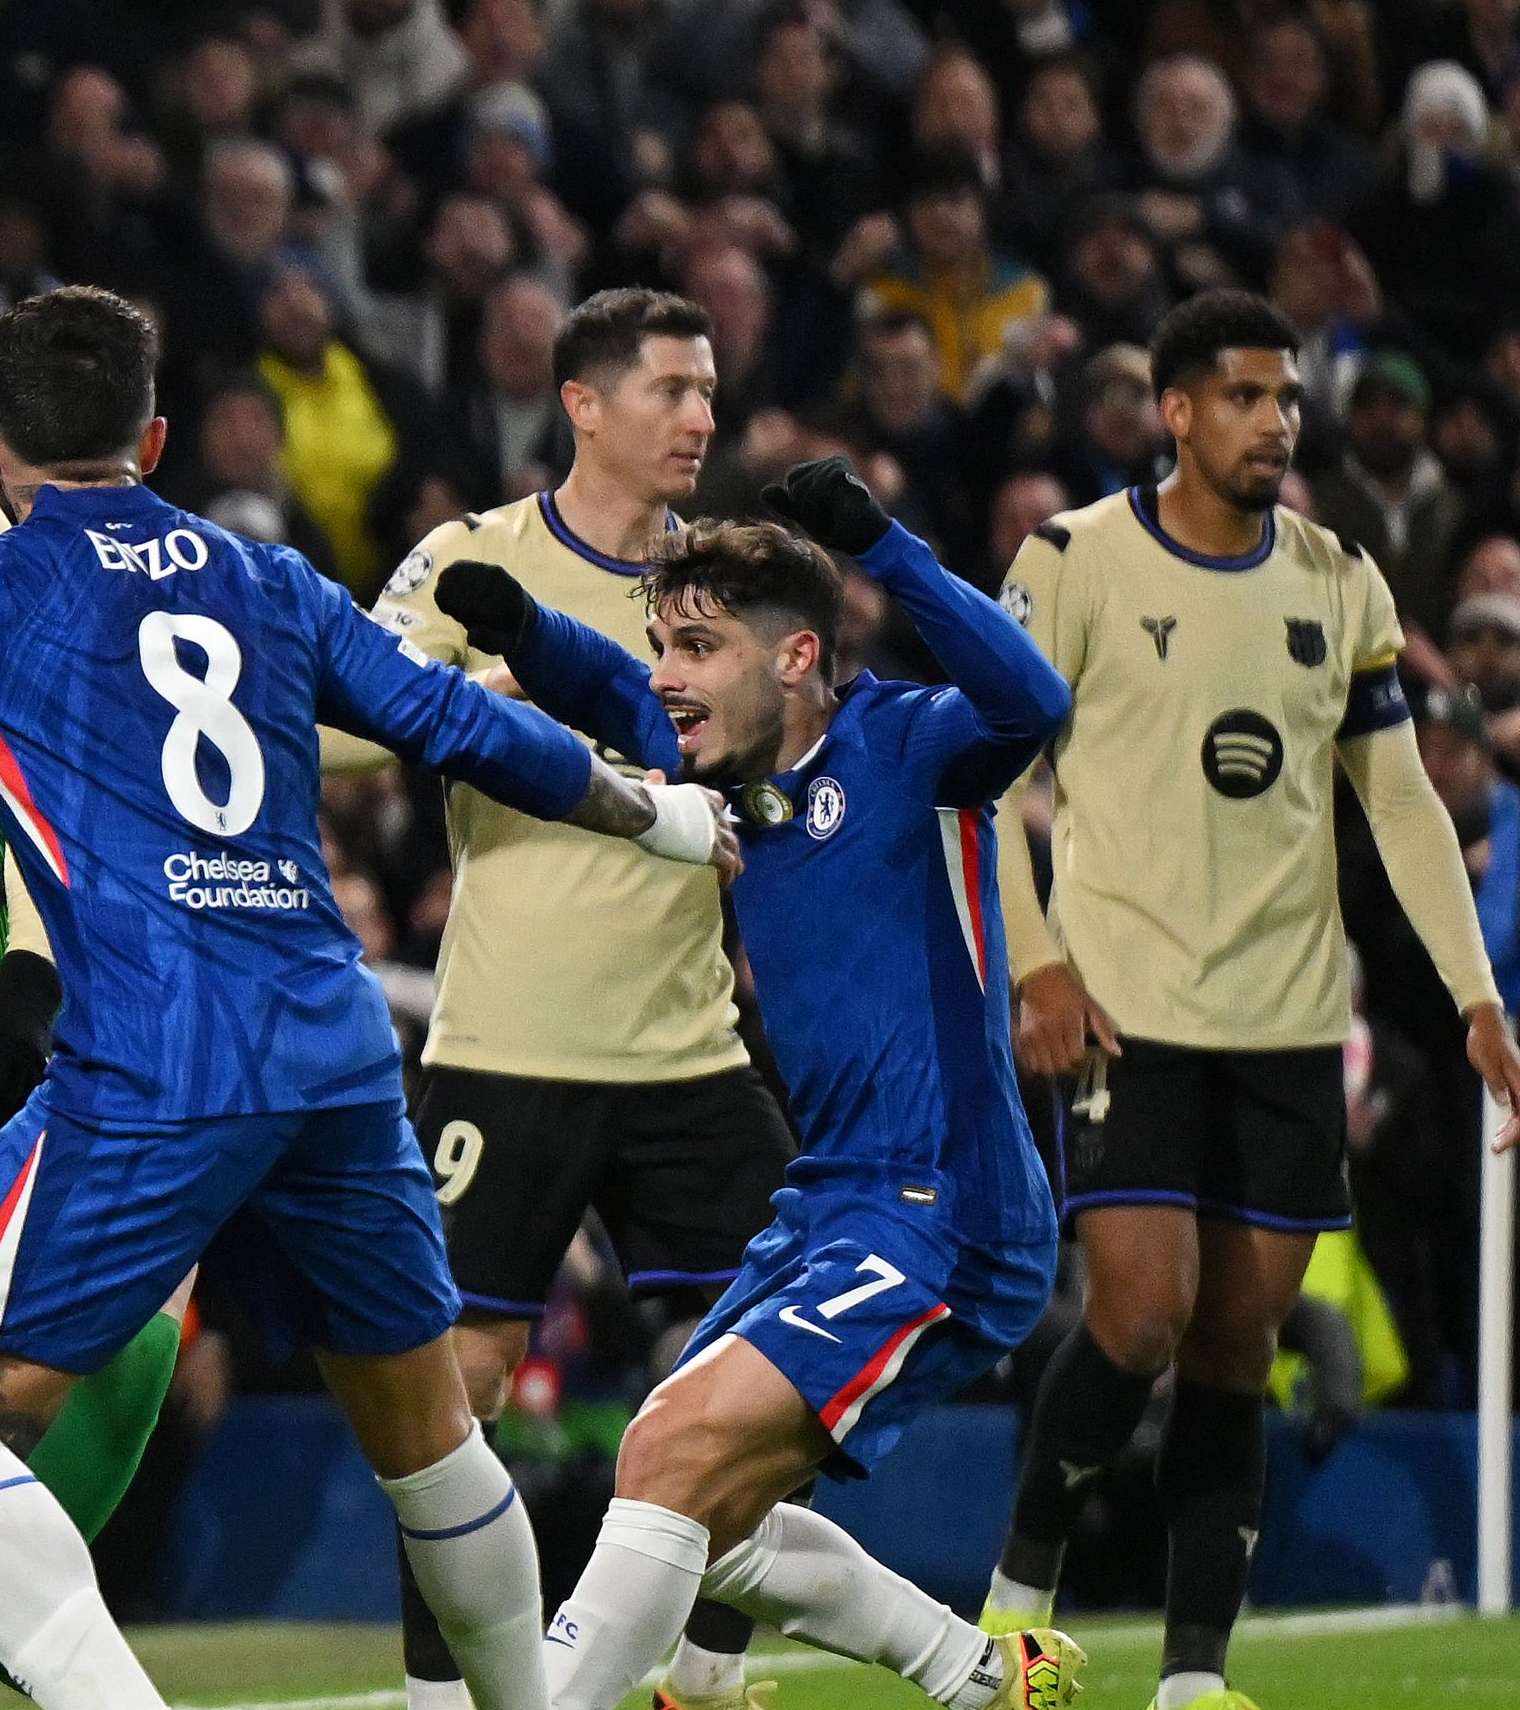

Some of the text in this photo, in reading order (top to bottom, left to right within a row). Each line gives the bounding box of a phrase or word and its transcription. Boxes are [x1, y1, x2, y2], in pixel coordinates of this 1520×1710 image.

[83, 528, 209, 581] ENZO
[138, 610, 265, 837] 8
[163, 851, 270, 884] Chelsea
[168, 881, 310, 911] Foundation
[433, 1119, 484, 1208] 9
[815, 1252, 907, 1319] 7
